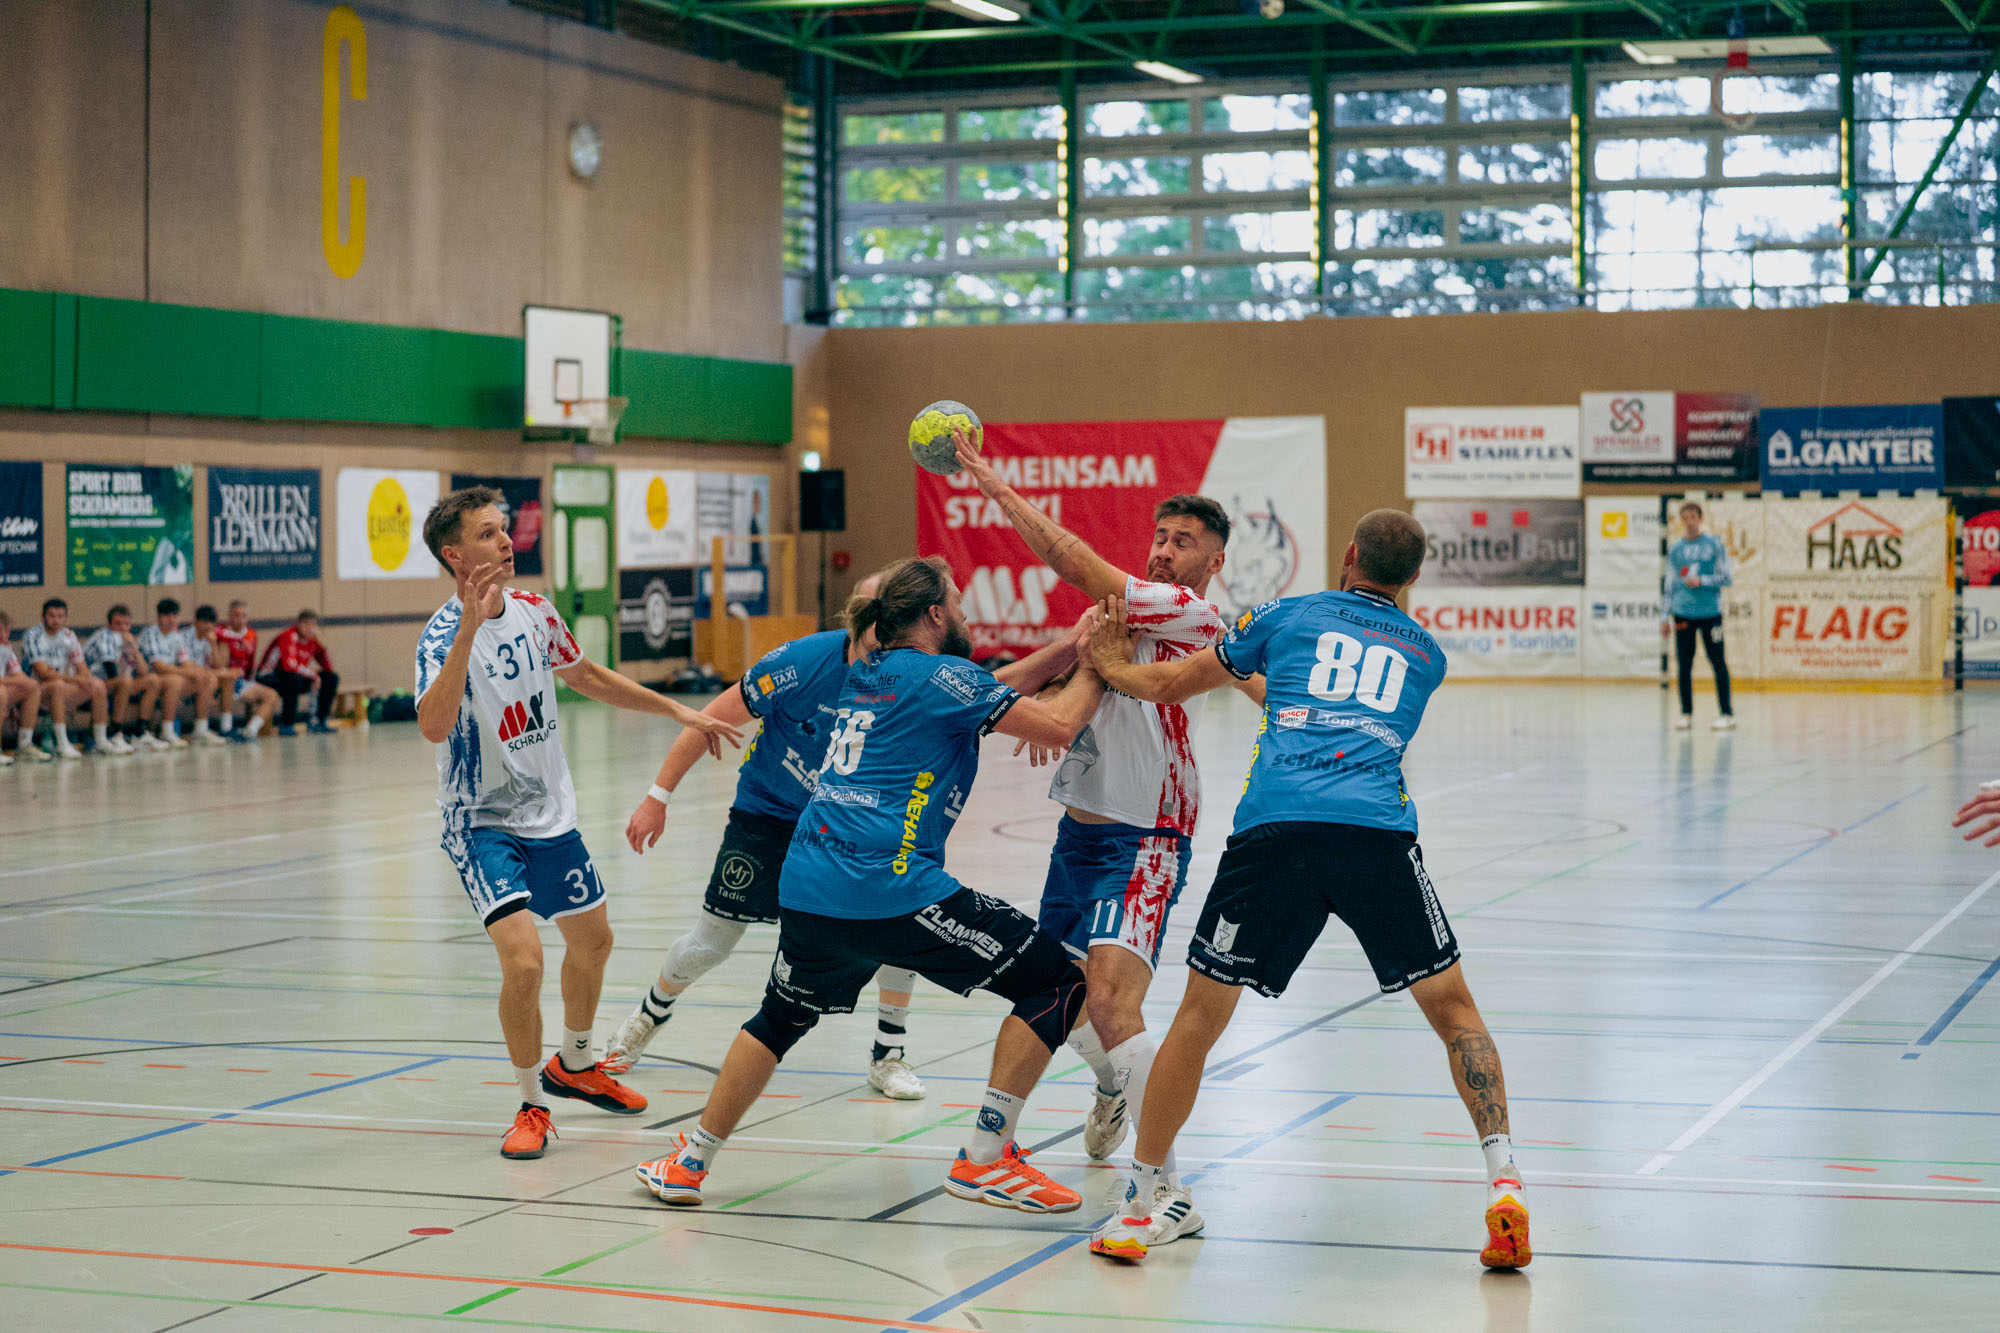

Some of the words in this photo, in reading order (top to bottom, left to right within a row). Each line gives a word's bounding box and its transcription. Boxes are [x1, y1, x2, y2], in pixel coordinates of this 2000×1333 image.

[322, 5, 366, 278] C
[220, 484, 310, 518] BRILLEN
[213, 515, 318, 553] LEHMANN
[1806, 519, 1903, 570] HAAS
[1253, 598, 1281, 614] TAXI
[1413, 605, 1577, 631] SCHNURR
[1339, 608, 1436, 650] Eisenbichler
[1770, 605, 1909, 642] FLAIG
[497, 633, 535, 681] 37
[1363, 628, 1430, 665] KFZ-Technik
[773, 669, 798, 686] TAXI
[939, 667, 975, 699] KROKODIL
[1308, 631, 1409, 714] 80
[989, 700, 1009, 721] Kempa
[1323, 713, 1356, 726] Toni
[564, 856, 606, 904] 37
[718, 885, 746, 902] Tadic
[1090, 899, 1119, 934] 11
[1016, 934, 1035, 955] Kempa
[994, 956, 1015, 976] Kempa
[1210, 967, 1235, 982] Kempa
[1407, 968, 1429, 981] Kempa
[1380, 980, 1404, 992] Kempa
[801, 1001, 823, 1012] Kempa
